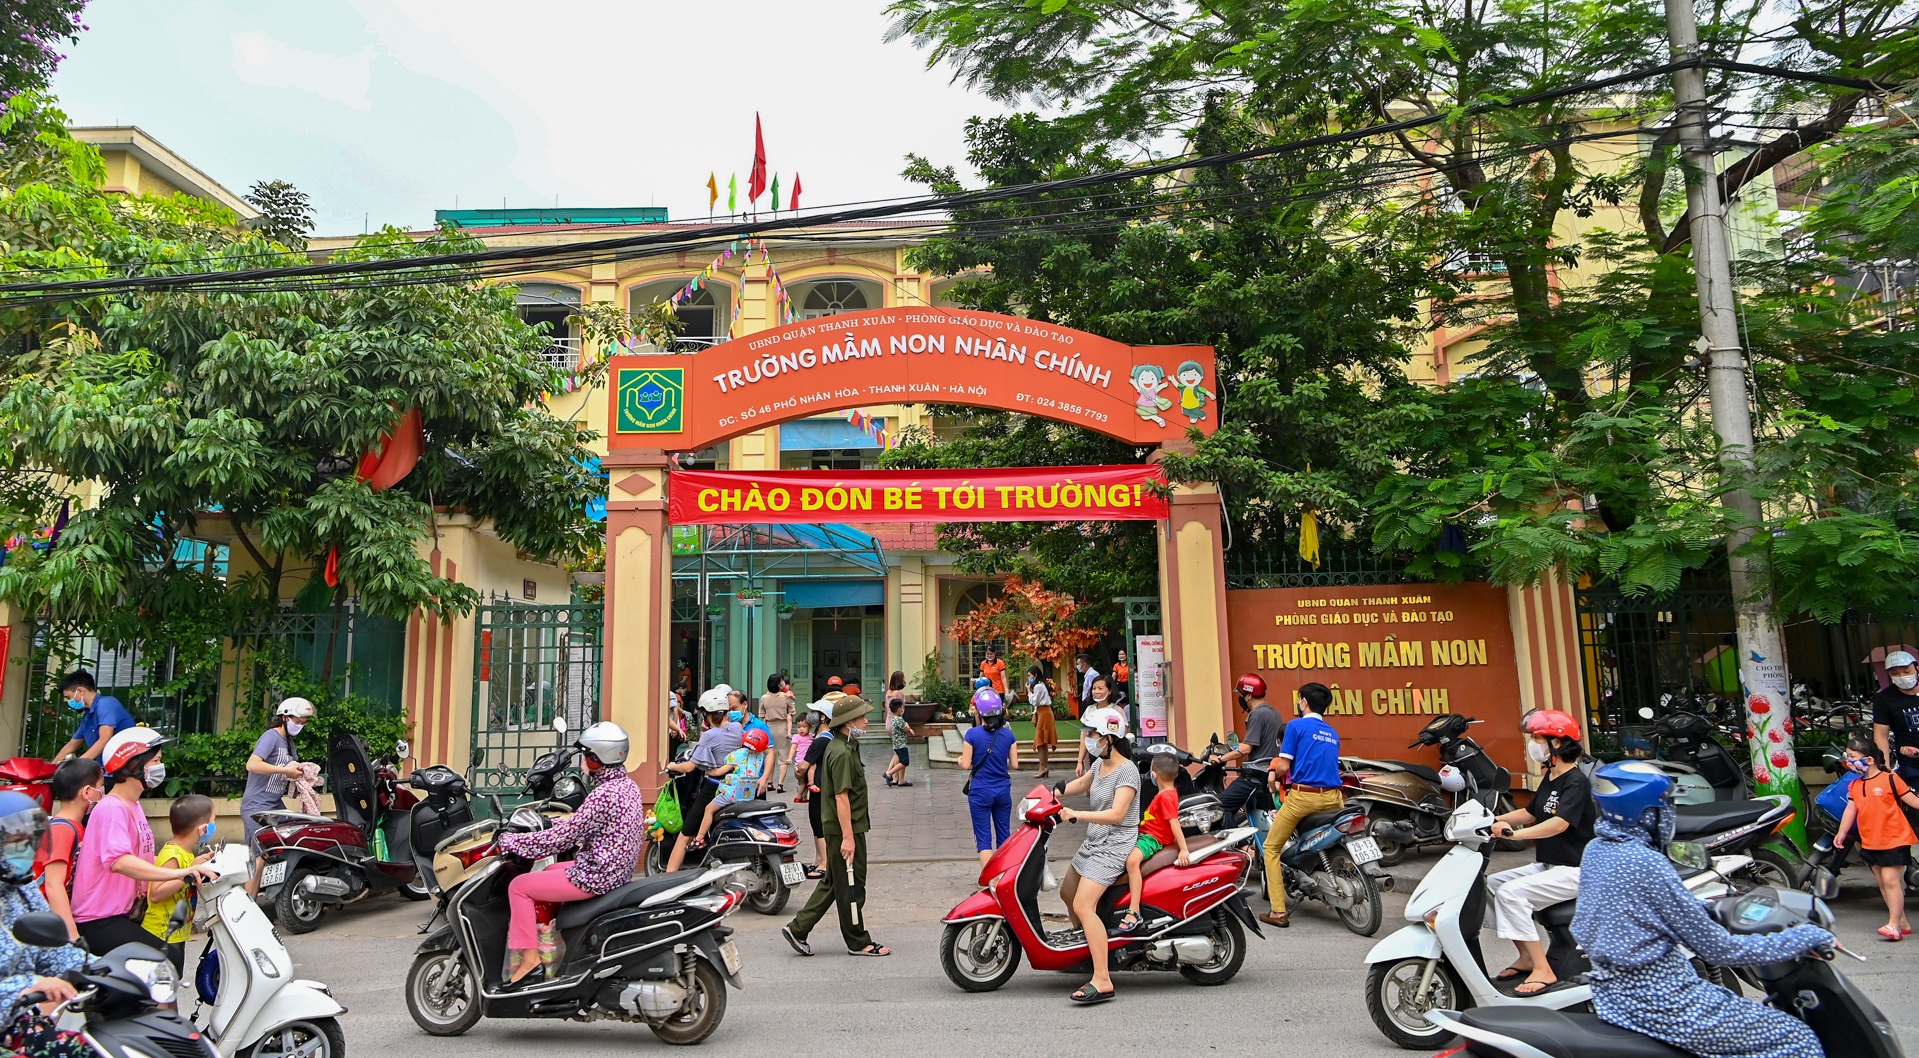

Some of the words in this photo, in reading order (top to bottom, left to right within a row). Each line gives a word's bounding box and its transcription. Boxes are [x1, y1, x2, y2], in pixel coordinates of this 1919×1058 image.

[748, 334, 781, 351] UBND
[782, 326, 816, 341] QUẬN
[818, 319, 859, 333] THANH
[862, 315, 896, 326] XUÂN
[905, 315, 946, 324] PHÒNG
[948, 315, 978, 326] GIÁO
[979, 318, 1003, 331] DỤC
[1006, 321, 1021, 333] VÀ
[1024, 325, 1049, 338] ĐÀO
[1051, 331, 1074, 345] TẠO
[713, 348, 817, 393] TRƯỜNG
[821, 332, 883, 365] MẦM
[889, 334, 945, 355] NON
[954, 336, 1027, 365] NHÂN
[1034, 352, 1112, 388] CHÍNH
[719, 415, 738, 427] ĐC:
[740, 406, 757, 421] SỐ
[759, 404, 772, 415] 46
[773, 395, 797, 411] PHỐ
[799, 391, 831, 405] NHÂN
[835, 386, 859, 398] HÒA
[868, 384, 906, 394] THANH
[908, 382, 940, 392] XUÂN
[949, 382, 965, 394] HÀ
[967, 384, 987, 397] NỘI
[1016, 393, 1034, 403] ĐT:
[1036, 396, 1055, 408] 024
[1057, 401, 1082, 415] 3858
[1084, 408, 1109, 423] 7793
[697, 482, 791, 512] CHÀO
[799, 482, 872, 511] ĐÓN
[883, 481, 923, 510] BÉ
[932, 480, 985, 509] TỚI
[995, 478, 1142, 509] TRƯỜNG!
[1275, 611, 1318, 626] PHÒNG
[1320, 611, 1351, 625] GIÁO
[1353, 612, 1379, 627] DỤC
[1382, 610, 1399, 623] VÀ
[1401, 609, 1428, 623] ĐÀO
[1430, 610, 1454, 625] TẠO
[1297, 599, 1327, 608] UBND
[1362, 597, 1398, 606] THANH
[1401, 594, 1432, 604] XUÂN
[1253, 636, 1351, 670] TRƯỜNG
[1358, 632, 1424, 668] MẦM
[1430, 639, 1488, 666] NON
[1371, 681, 1450, 715] CHÍNH
[1182, 876, 1219, 891] LEAD
[648, 908, 685, 919] LEAD
